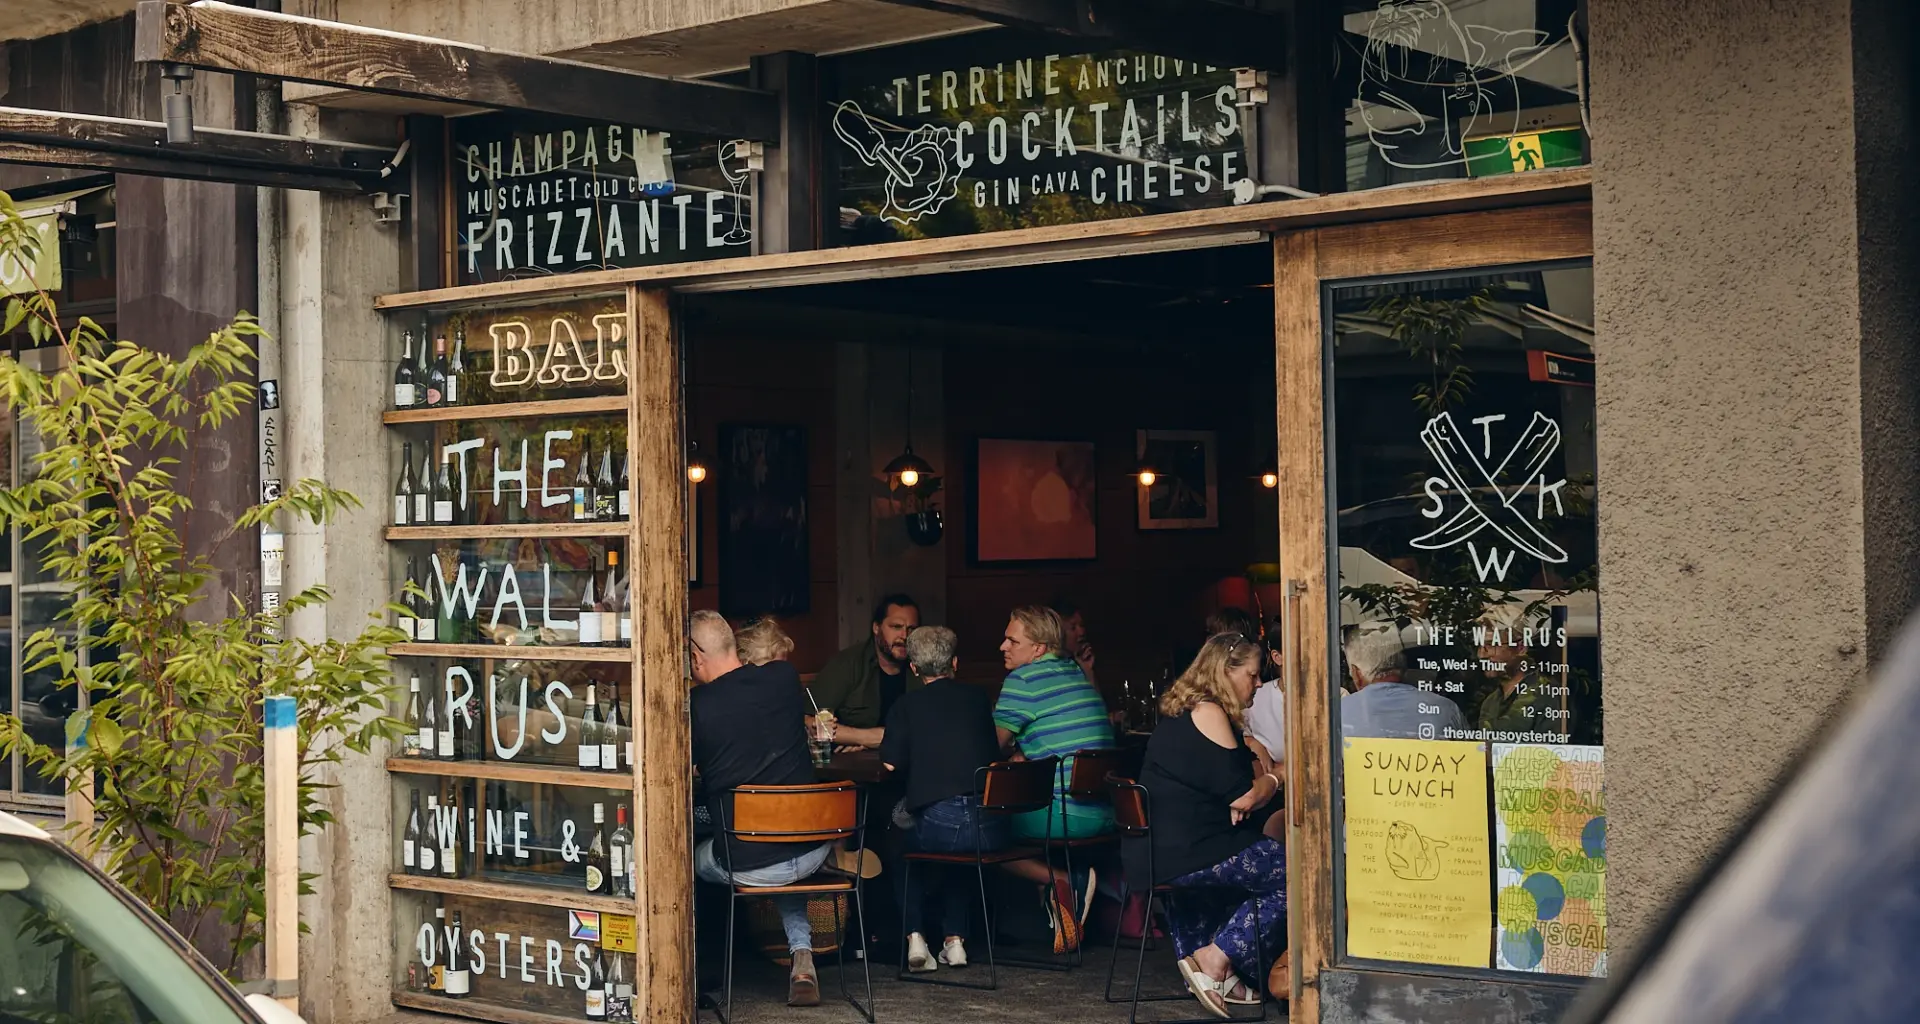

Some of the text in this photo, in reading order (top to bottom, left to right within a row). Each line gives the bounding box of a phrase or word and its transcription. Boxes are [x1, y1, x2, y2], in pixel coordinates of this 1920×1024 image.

[892, 54, 1060, 117] TERRINE
[956, 85, 1237, 169] COCKTAILS
[468, 176, 577, 214] MUSCADET
[584, 178, 619, 199] COLD
[974, 151, 1238, 208] GIN CAVA CHEESE
[467, 190, 724, 273] FRIZZANTE
[489, 313, 629, 386] BAR
[1472, 413, 1506, 459] T
[447, 430, 573, 511] THE
[1421, 476, 1449, 519] S
[1537, 473, 1567, 519] K
[1467, 541, 1515, 582] W
[432, 554, 578, 631] WAL
[1415, 626, 1567, 647] THE WALRUS
[1417, 657, 1440, 671] Tue,
[1443, 658, 1467, 670] Wed
[1479, 659, 1506, 671] Thur
[1520, 660, 1528, 672] 3
[1538, 661, 1569, 675] 11pm
[1418, 680, 1433, 692] Fri
[1444, 681, 1464, 693] Sat
[1514, 683, 1528, 695] 12
[1538, 684, 1570, 698] 11pm
[445, 666, 573, 760] RUS
[1418, 702, 1440, 714] Sun
[1521, 706, 1535, 718] 12
[1545, 707, 1570, 721] 8pm
[1443, 726, 1571, 744] thewalrusoysterbar
[1363, 752, 1466, 775] SUNDAY
[1373, 777, 1455, 799] LUNCH
[435, 805, 580, 863] WINE &
[1348, 816, 1379, 825] OYSTERS
[1352, 829, 1384, 838] SEAFOOD
[1361, 867, 1378, 875] MAX
[1363, 855, 1376, 863] THE
[1430, 892, 1442, 901] THE
[420, 922, 592, 991] OYSTERS
